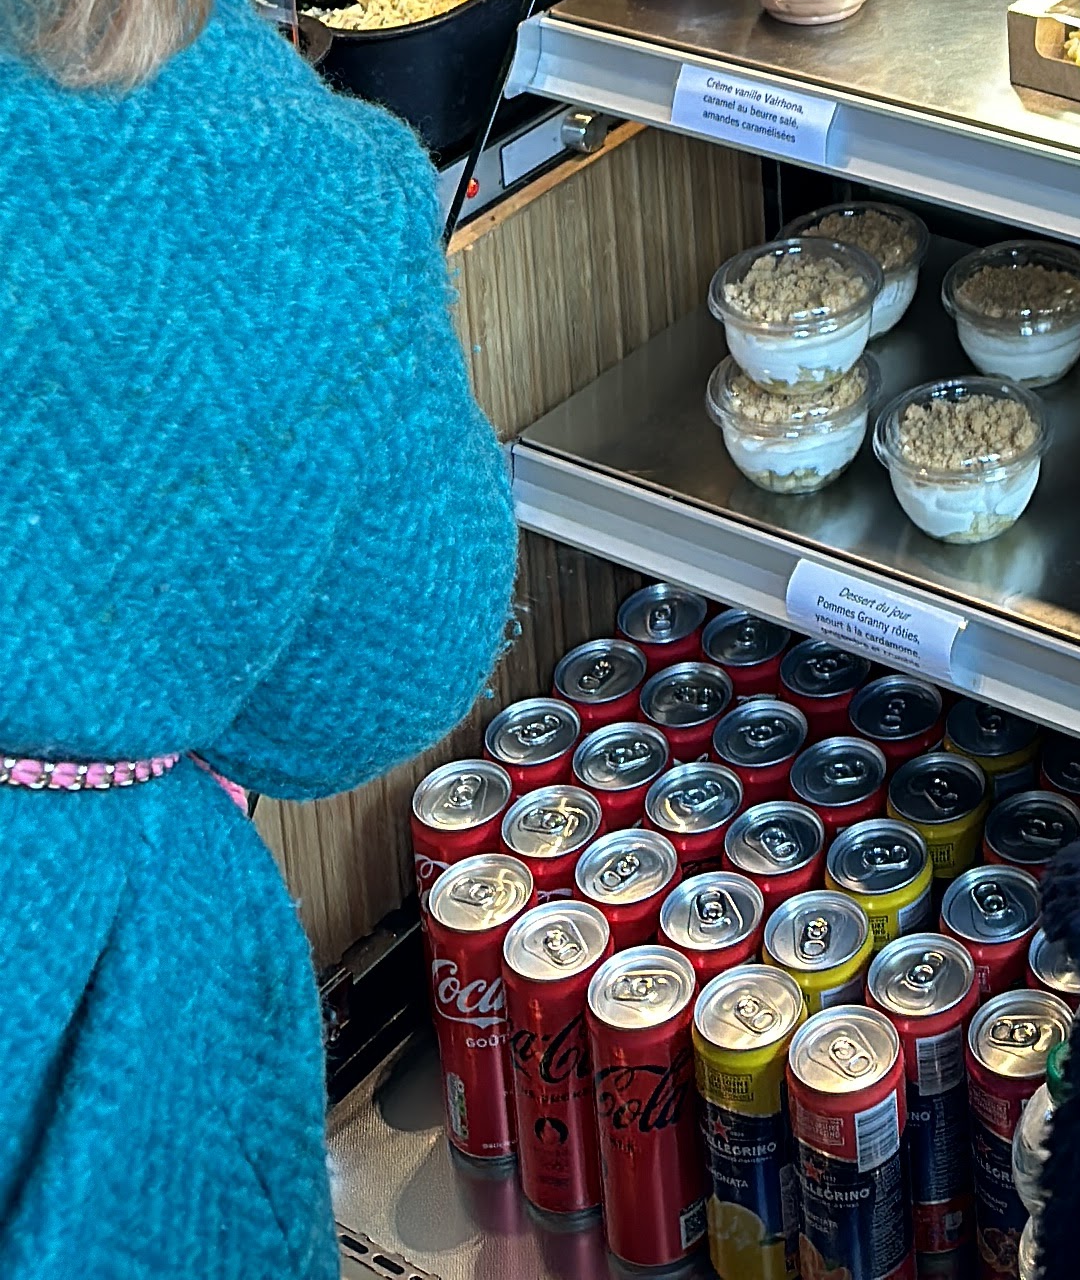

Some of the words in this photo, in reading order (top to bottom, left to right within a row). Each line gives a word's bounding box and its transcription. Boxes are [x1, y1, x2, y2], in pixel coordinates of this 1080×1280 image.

[706, 76, 733, 94] Crème
[735, 87, 762, 102] vanille
[703, 93, 735, 110] caramel
[737, 104, 748, 114] au
[750, 105, 778, 123] beurre
[702, 109, 739, 128] amandes
[742, 122, 796, 143] caramélisées
[816, 595, 855, 620] Pommes
[857, 611, 890, 633] Granny
[891, 624, 920, 645] rôties,
[838, 587, 876, 609] Dessert
[875, 601, 890, 614] du
[887, 607, 912, 622] jour
[815, 613, 844, 630] yaourt
[854, 626, 862, 637] la
